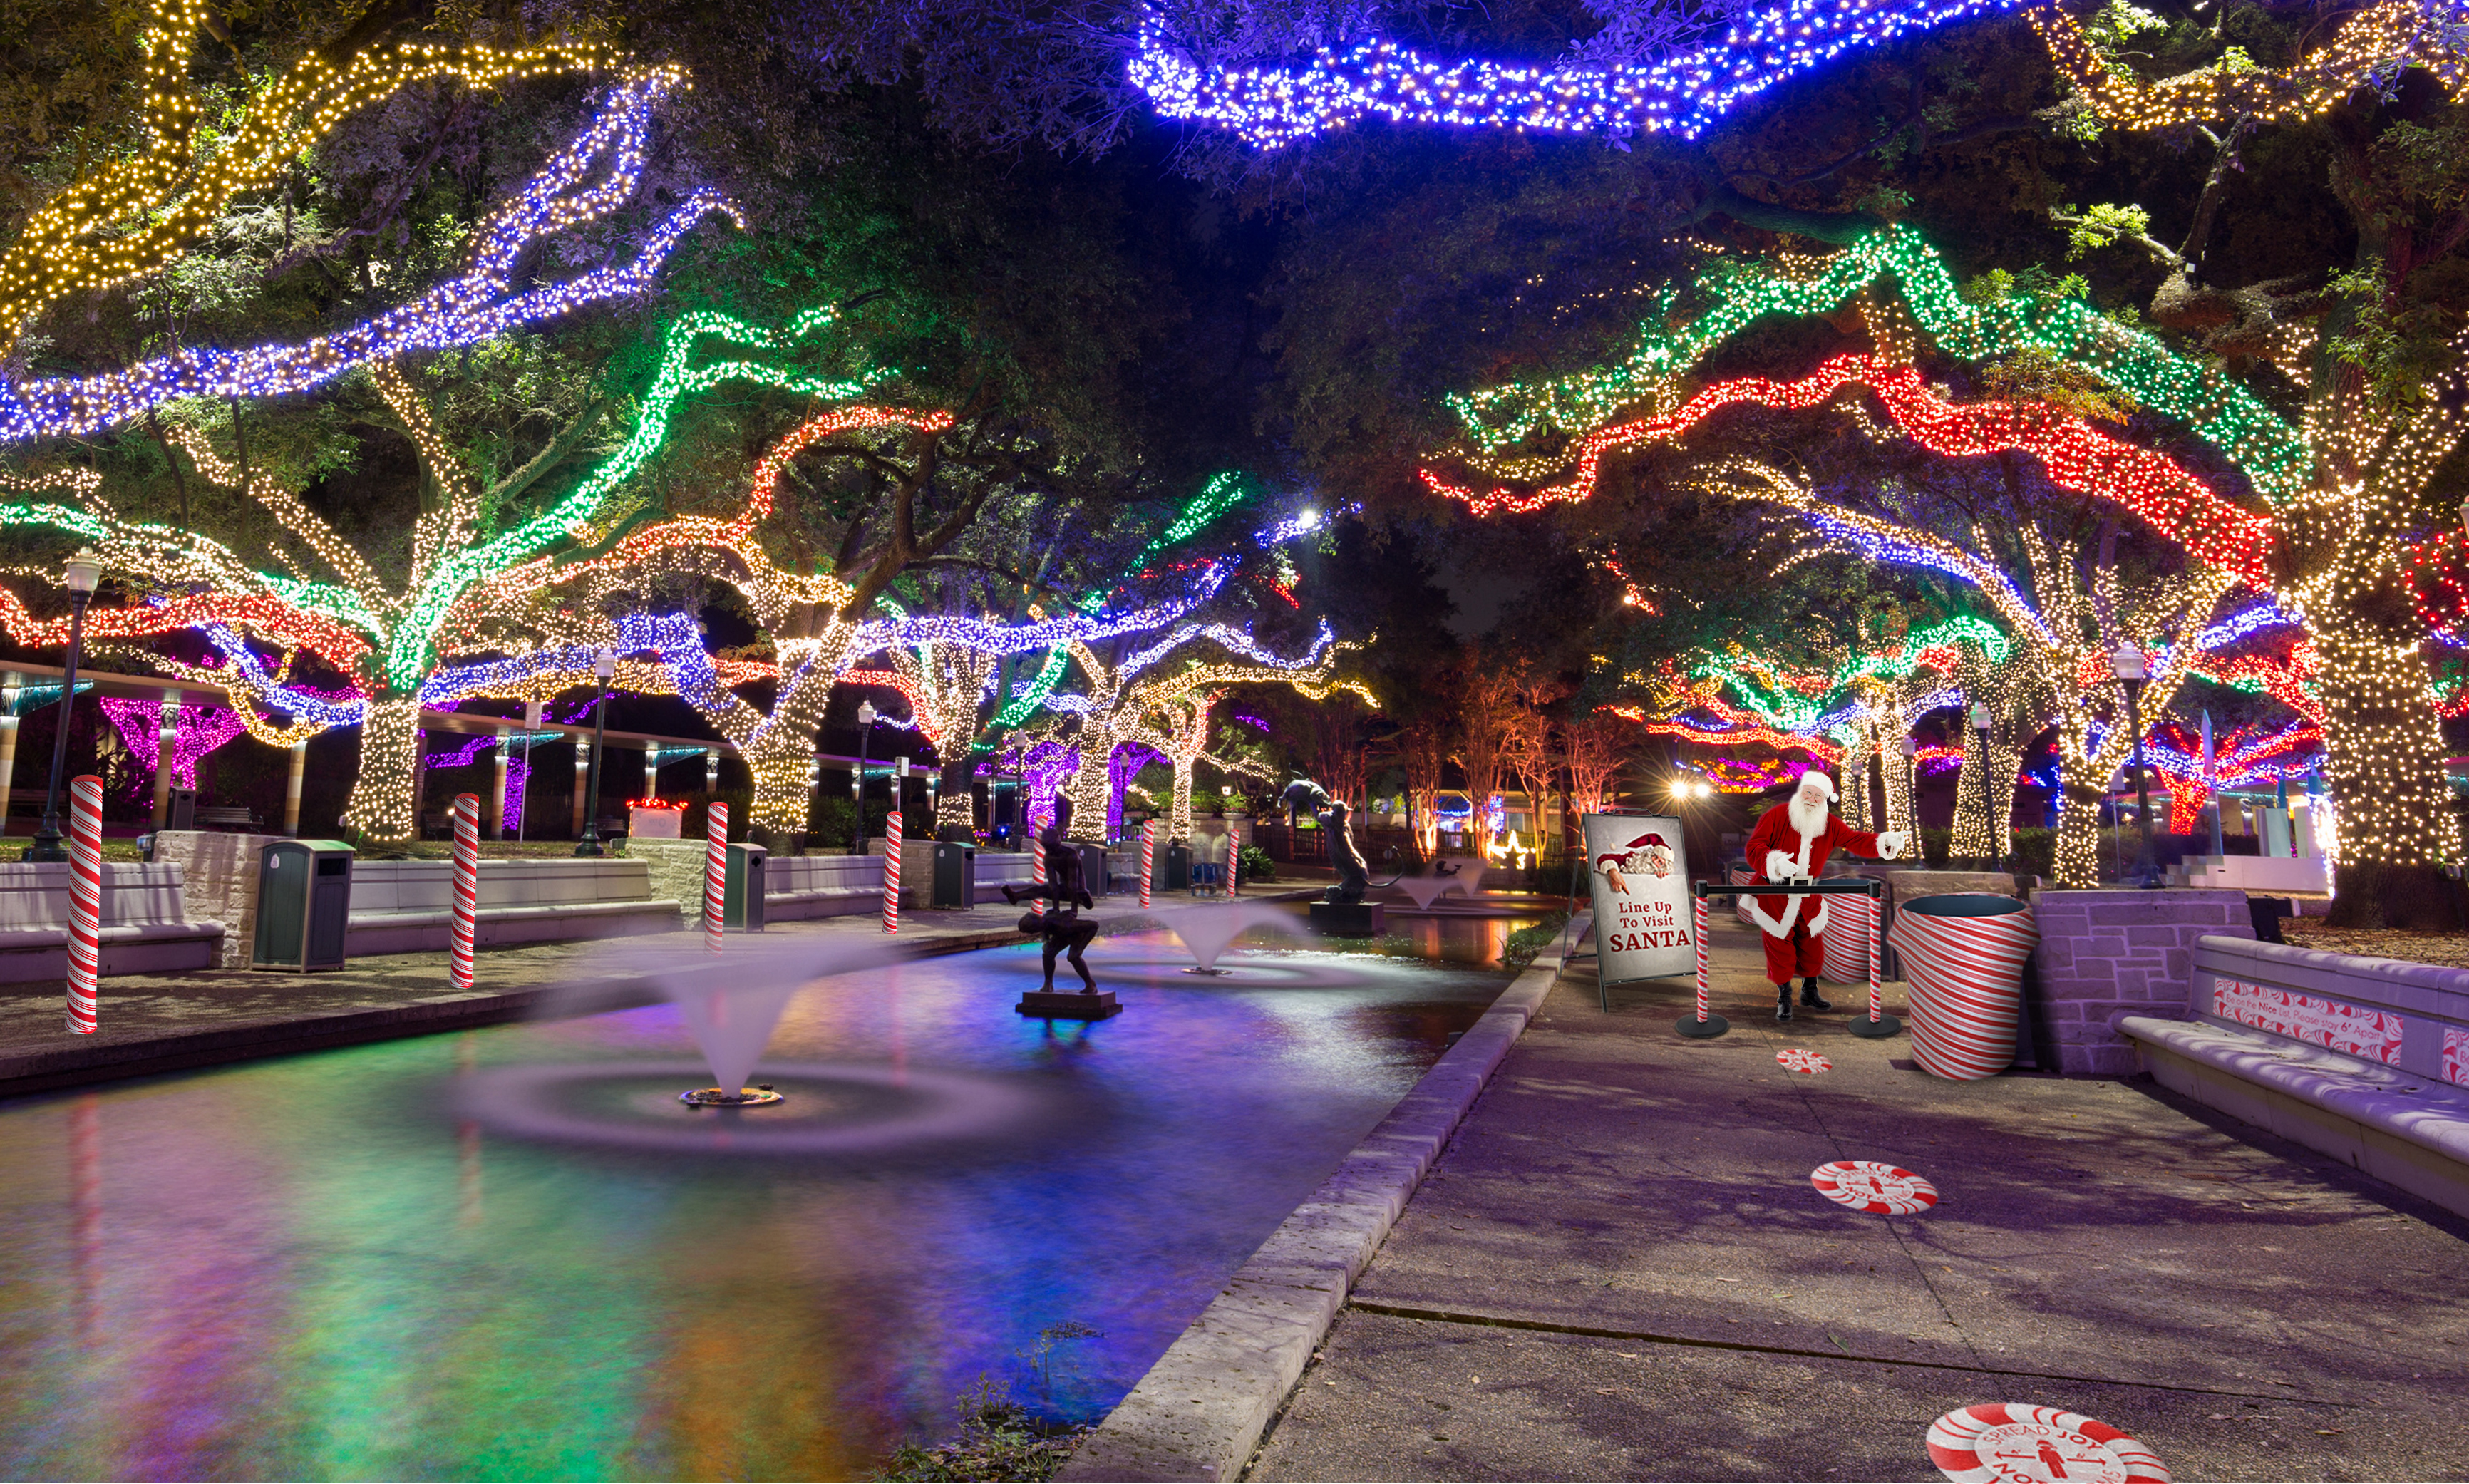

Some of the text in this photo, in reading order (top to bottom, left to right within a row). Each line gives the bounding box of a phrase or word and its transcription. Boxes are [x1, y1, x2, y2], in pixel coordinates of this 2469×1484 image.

[1619, 902, 1672, 914] Line Up
[1619, 915, 1674, 929] To Visit
[1609, 929, 1691, 952] SANTA
[2226, 993, 2235, 1004] Be
[2236, 999, 2245, 1007] on
[2246, 999, 2257, 1009] the
[2258, 1001, 2277, 1014] Nice
[2294, 1009, 2319, 1026] Please
[2321, 1019, 2339, 1033] stay
[2354, 1025, 2381, 1041] Apart
[1983, 1425, 2104, 1450] SPREAD JOY
[1992, 1463, 2048, 1483] NO
